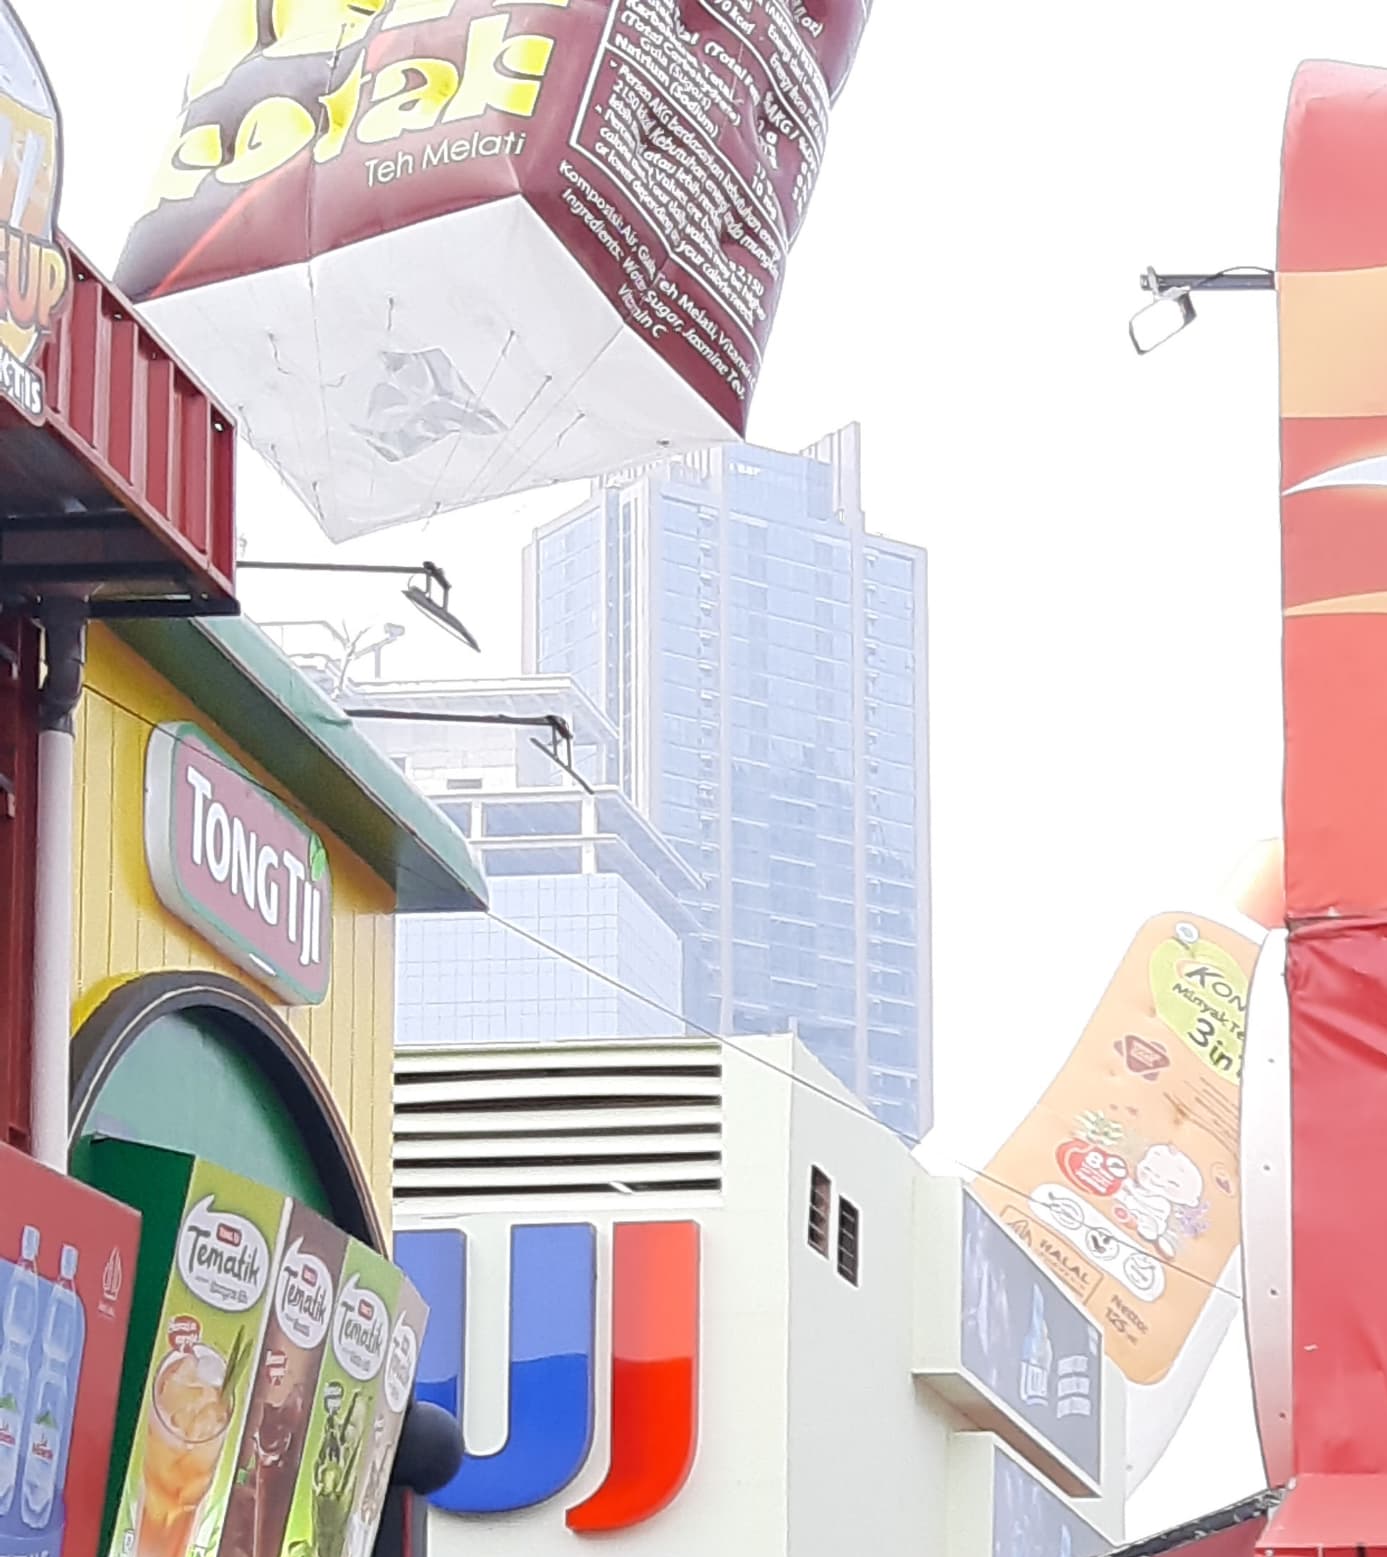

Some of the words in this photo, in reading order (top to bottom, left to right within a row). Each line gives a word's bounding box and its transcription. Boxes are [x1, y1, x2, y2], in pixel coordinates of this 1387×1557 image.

[365, 158, 414, 188] Teh
[422, 131, 527, 170] Melati
[186, 766, 279, 926] TONG
[1187, 1017, 1216, 1048] 3
[187, 1225, 260, 1286] Tematik
[1040, 1239, 1091, 1286] HALAL
[284, 1266, 327, 1324] Tematik
[341, 1300, 383, 1357] Tematik
